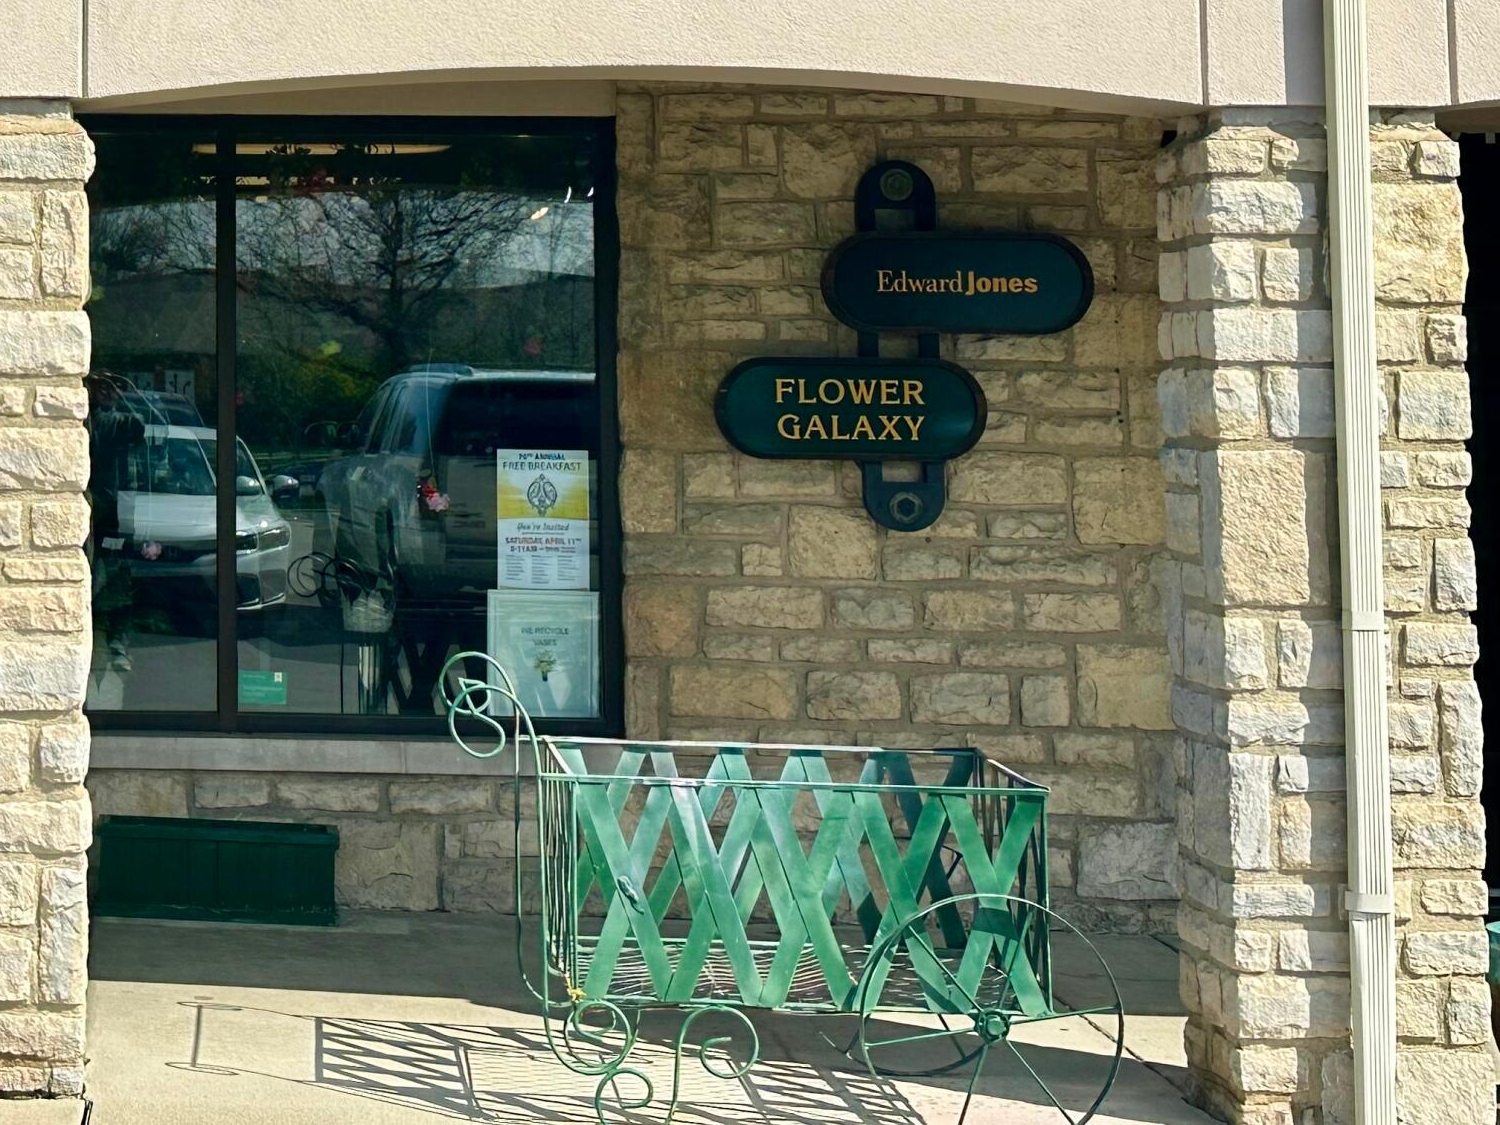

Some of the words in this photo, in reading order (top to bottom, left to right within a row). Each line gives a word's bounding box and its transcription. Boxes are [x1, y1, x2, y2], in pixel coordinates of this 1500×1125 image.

[876, 269, 963, 293] Edward
[965, 270, 1038, 296] Jones
[775, 378, 926, 405] FLOWER
[776, 414, 926, 441] GALAXY
[502, 461, 526, 471] FREE
[528, 461, 582, 471] BREAKFAST
